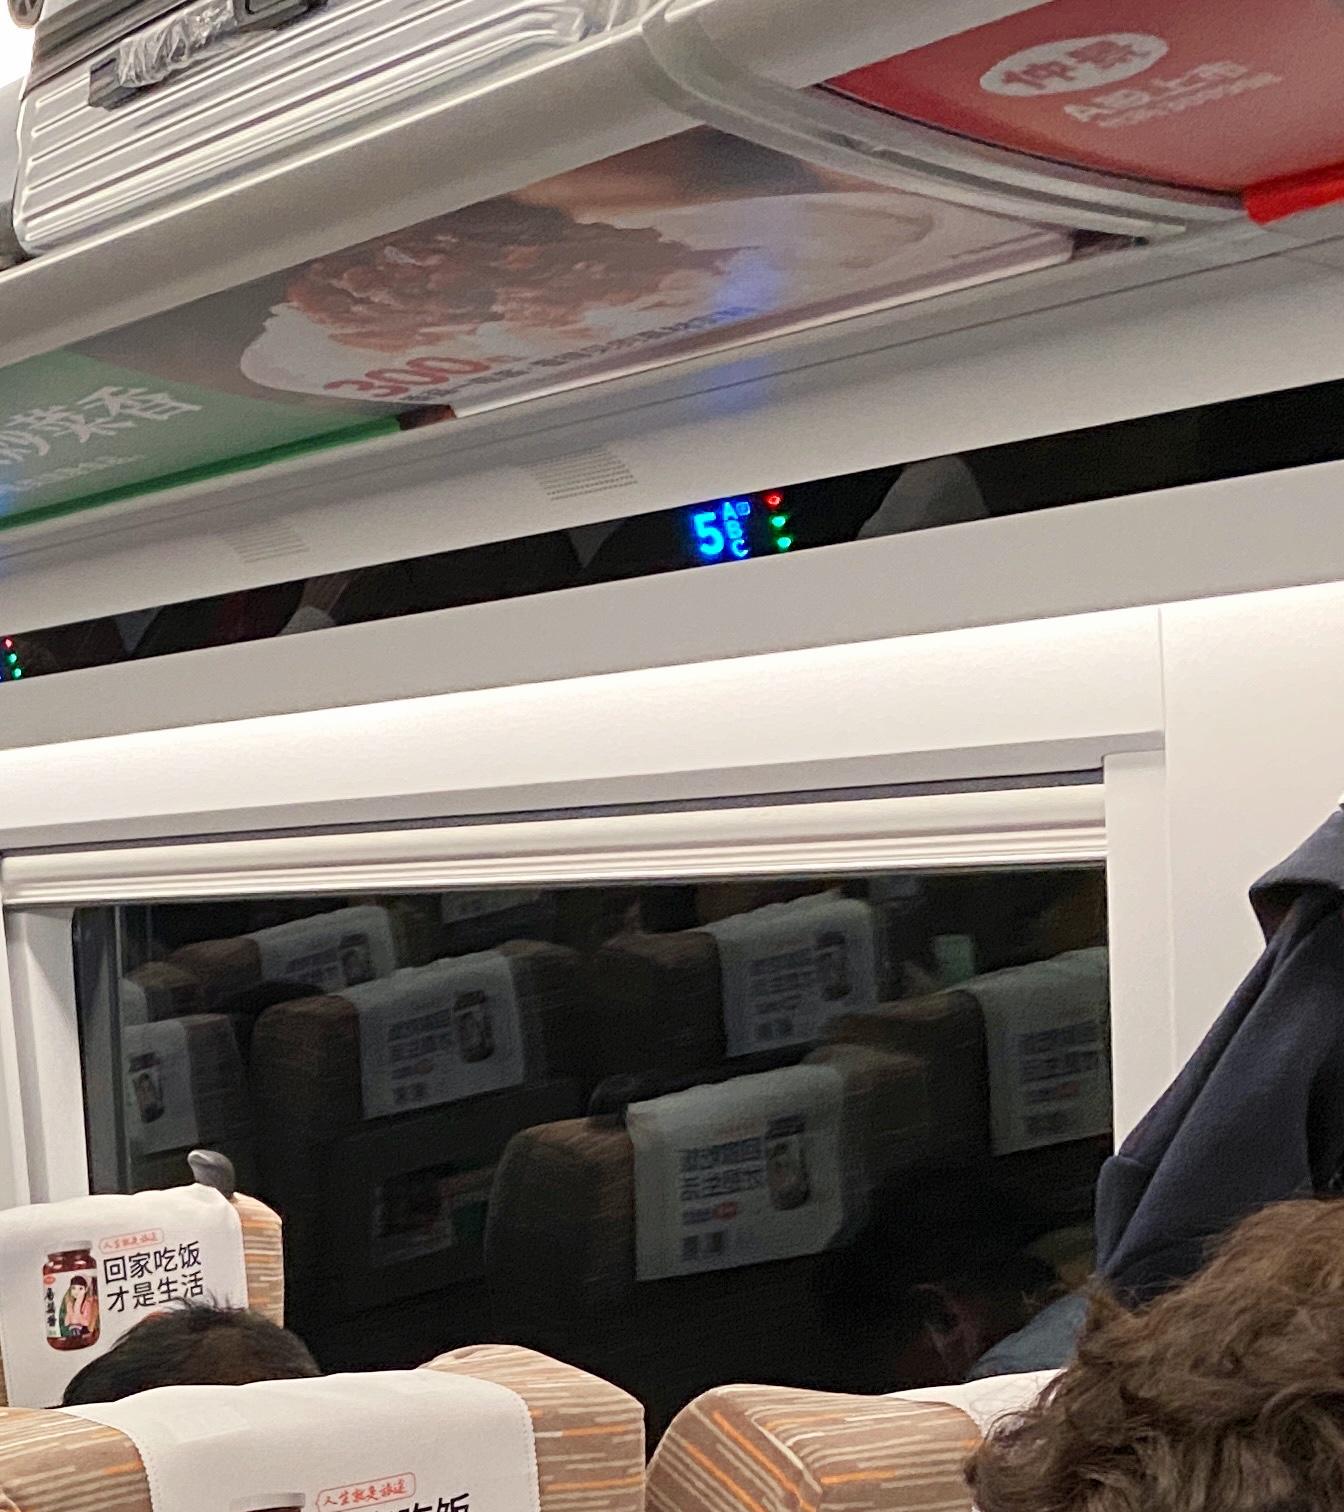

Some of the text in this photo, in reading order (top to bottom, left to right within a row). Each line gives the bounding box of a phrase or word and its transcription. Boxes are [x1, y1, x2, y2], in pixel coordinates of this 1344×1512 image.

[323, 356, 490, 398] 300
[694, 512, 724, 555] 5
[103, 1241, 202, 1284] 回家吃饭
[106, 1270, 204, 1313] 才是生活
